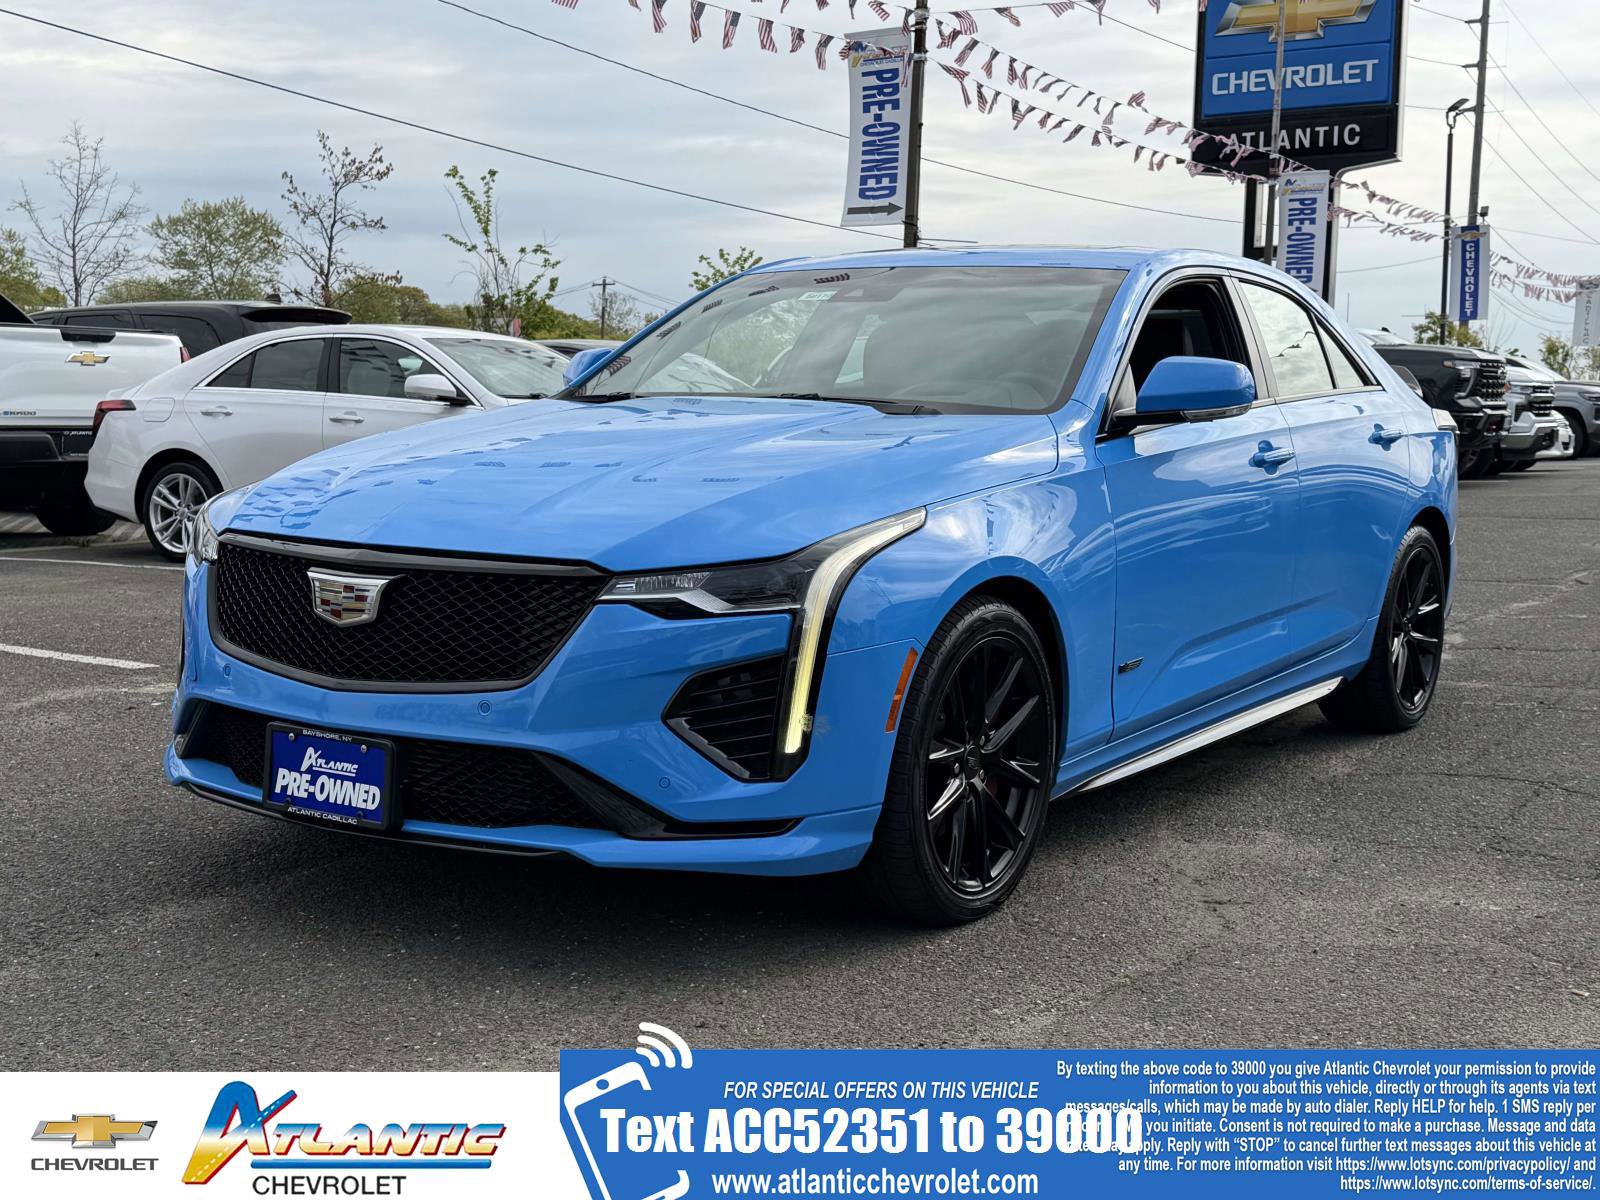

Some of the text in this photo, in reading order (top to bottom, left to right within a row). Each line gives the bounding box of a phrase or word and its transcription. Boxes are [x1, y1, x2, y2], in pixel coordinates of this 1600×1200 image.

[1212, 59, 1379, 95] CHEVROLET
[858, 67, 901, 200] PRE-OWNED
[1227, 123, 1361, 151] ATLANTIC
[1464, 243, 1475, 317] CHEVROLET
[302, 729, 341, 741] BAYSHORE,
[300, 746, 359, 773] ATLANTIC
[274, 768, 381, 811] PRE-OWNED
[287, 806, 358, 825] ATLANTIC CADILLAC
